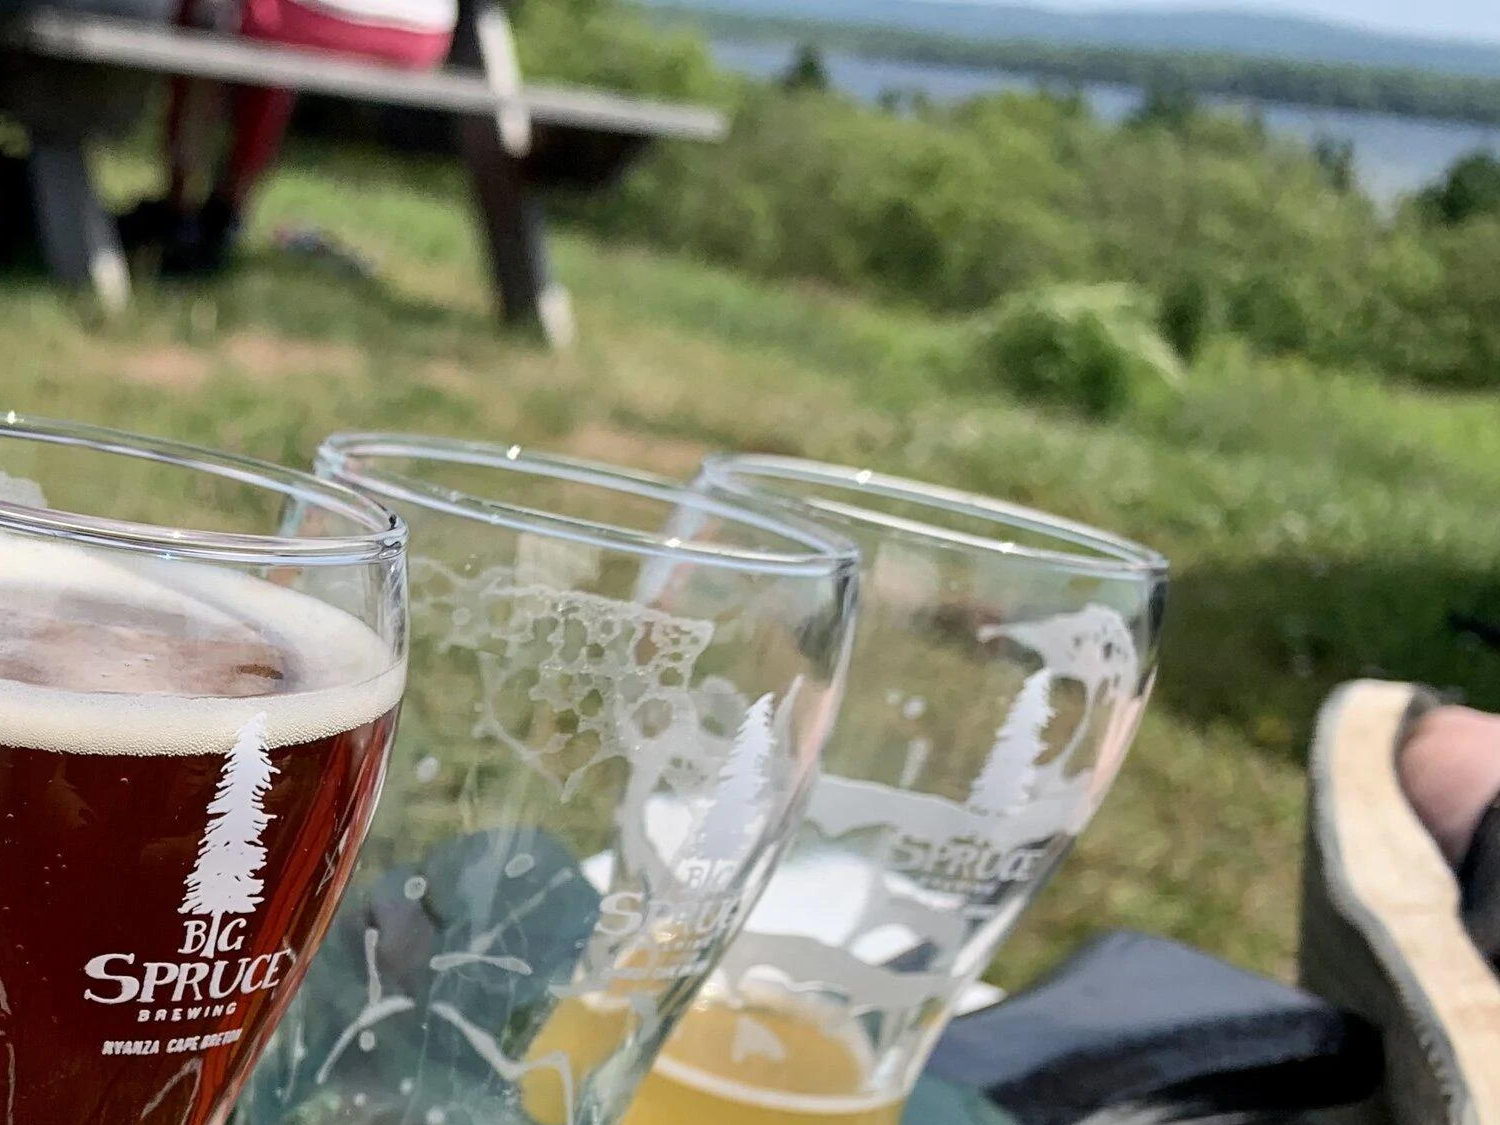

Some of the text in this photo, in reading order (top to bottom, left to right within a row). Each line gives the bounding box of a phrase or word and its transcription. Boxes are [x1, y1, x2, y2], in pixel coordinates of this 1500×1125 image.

[177, 917, 247, 958] BIG
[83, 948, 291, 1004] SPRUCE
[137, 1002, 237, 1023] BREWING
[101, 1040, 160, 1055] NYANZA
[166, 1036, 200, 1053] CAPE
